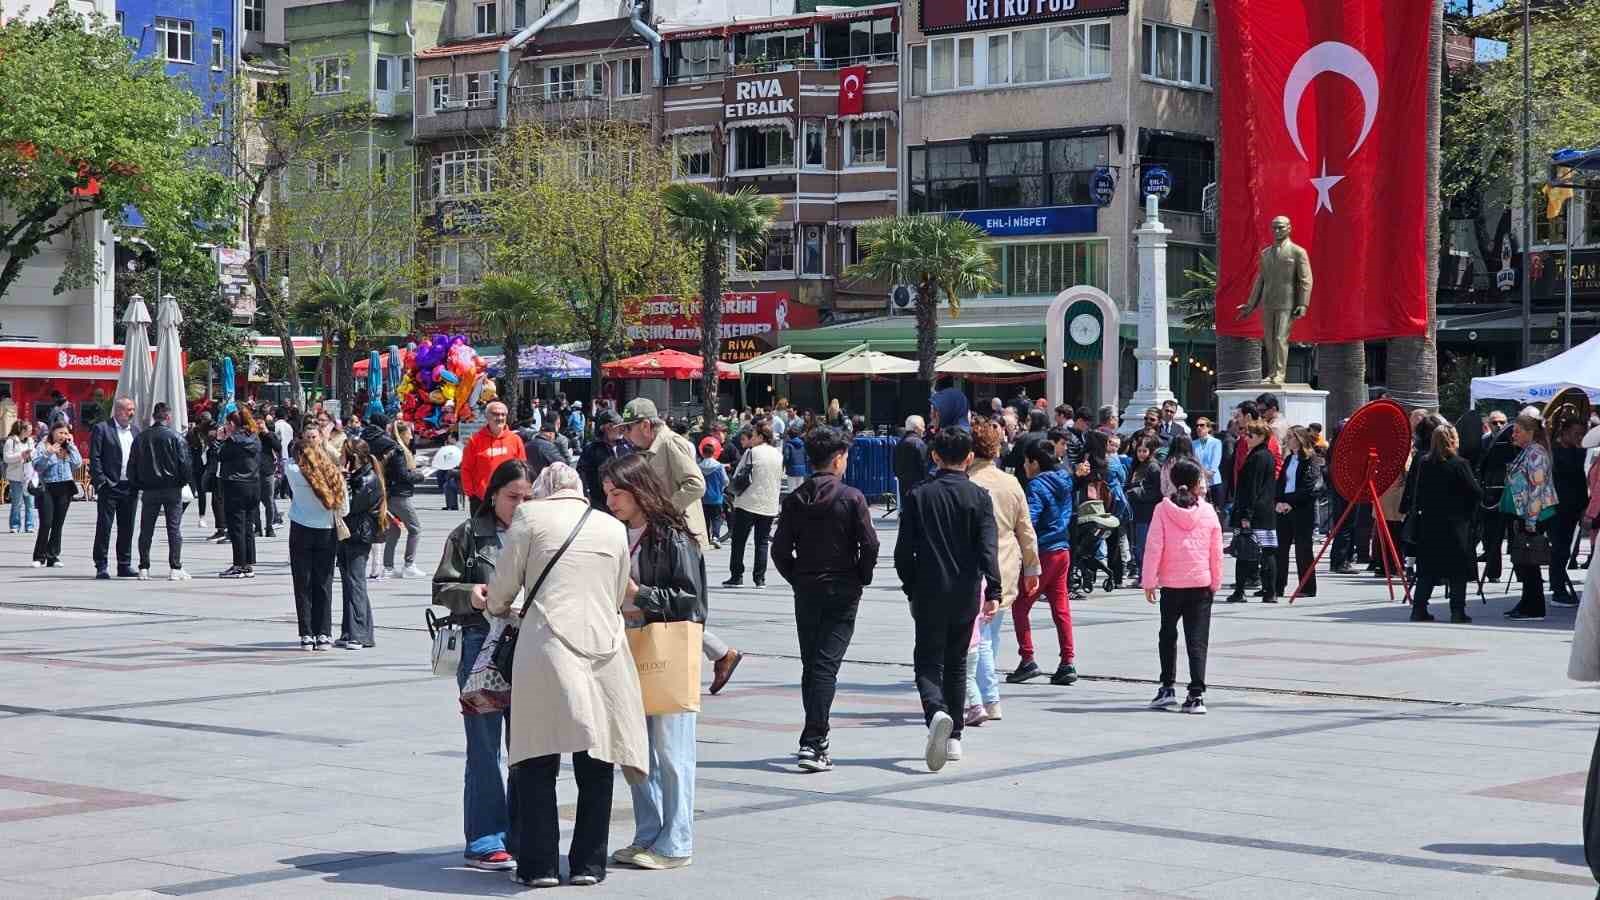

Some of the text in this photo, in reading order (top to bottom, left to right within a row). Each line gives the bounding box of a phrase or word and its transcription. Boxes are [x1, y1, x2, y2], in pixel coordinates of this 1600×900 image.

[725, 98, 794, 118] ET BALIK
[986, 215, 1047, 229] EHL-İ NİSPET
[68, 354, 123, 367] Ziraat Bankas
